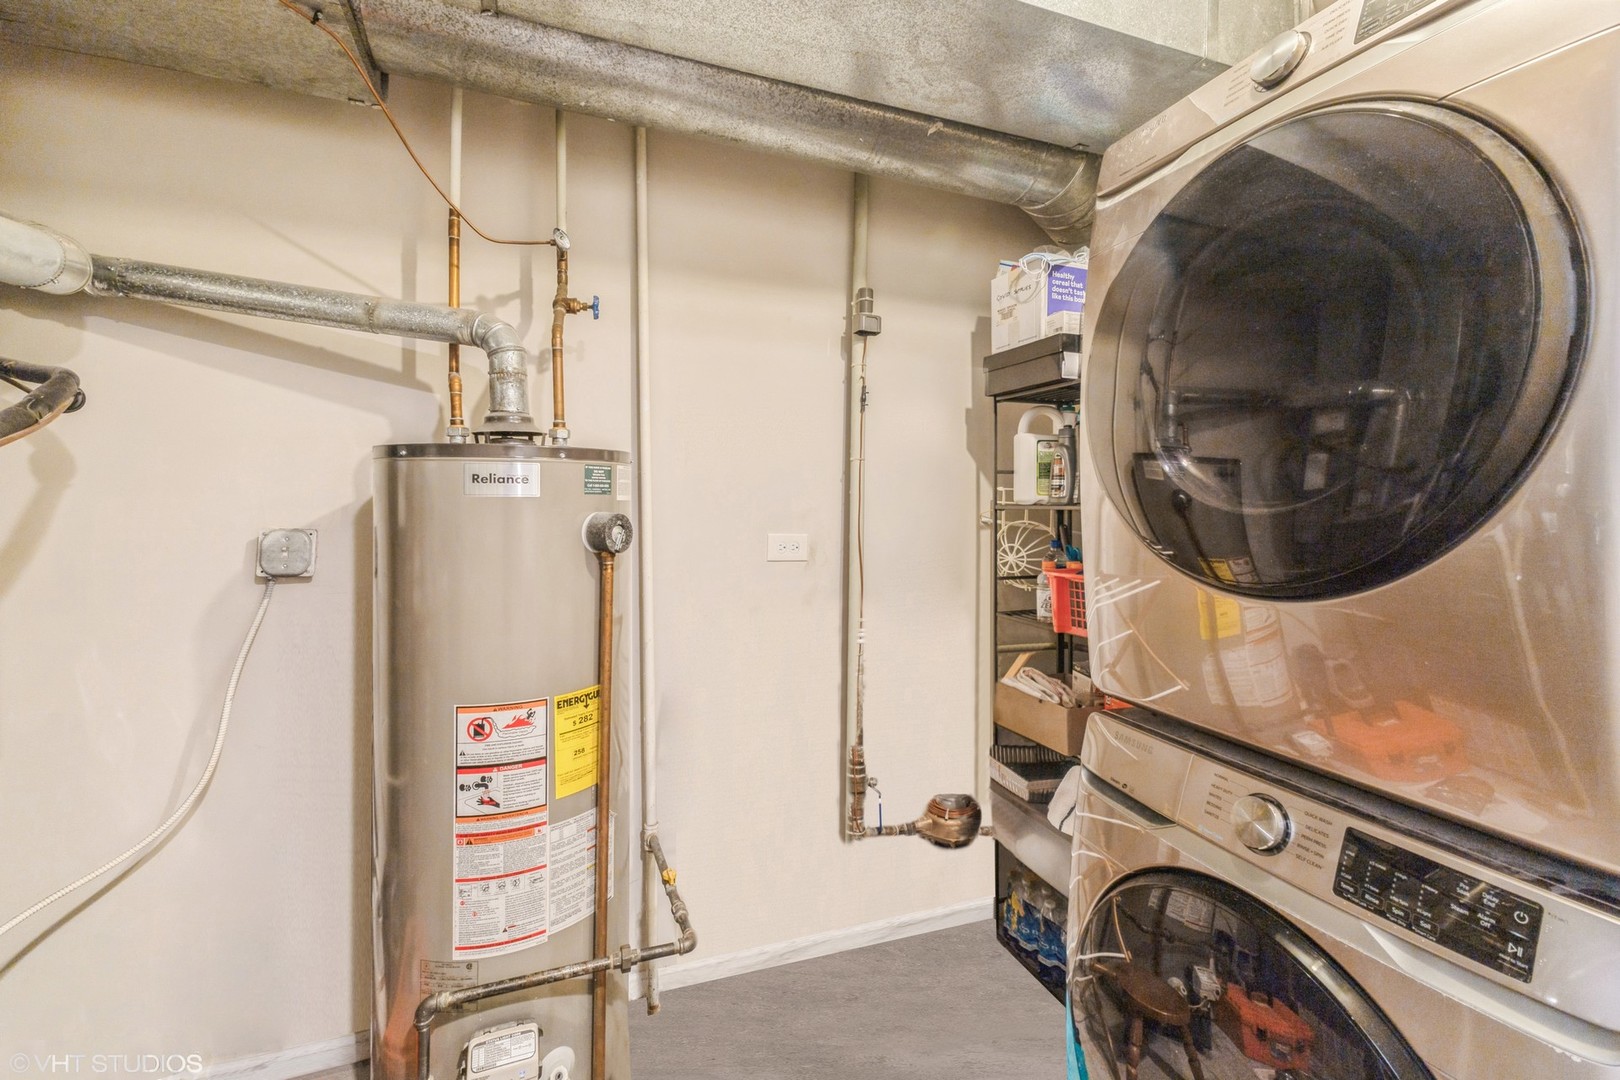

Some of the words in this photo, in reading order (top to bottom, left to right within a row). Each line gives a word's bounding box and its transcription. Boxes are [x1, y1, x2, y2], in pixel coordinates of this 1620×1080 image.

[1052, 271, 1075, 281] Healthy
[1052, 279, 1071, 287] cereal
[1071, 281, 1083, 289] that
[1052, 286, 1073, 294] doesn't
[472, 474, 529, 484] Reliance
[557, 689, 600, 710] ENERGYGU
[578, 714, 594, 724] 282
[1114, 731, 1154, 755] SAMSUNG
[574, 748, 586, 756] 258
[499, 764, 523, 772] DANGER
[1304, 810, 1318, 820] QUICK
[1318, 816, 1333, 826] WASH
[1305, 824, 1330, 839] DELICATES
[1300, 834, 1314, 843] PERM
[1314, 840, 1327, 849] PRESS
[1296, 853, 1306, 862] SELF
[1306, 858, 1323, 870] CLEAN
[1364, 894, 1380, 905] Rinse
[1482, 892, 1500, 904] Delay
[1482, 898, 1496, 908] End
[1391, 907, 1405, 917] Spin
[1450, 904, 1470, 916] Steam
[1477, 912, 1496, 924] Alarm
[1420, 920, 1432, 930] Soil
[1479, 920, 1492, 929] Off
